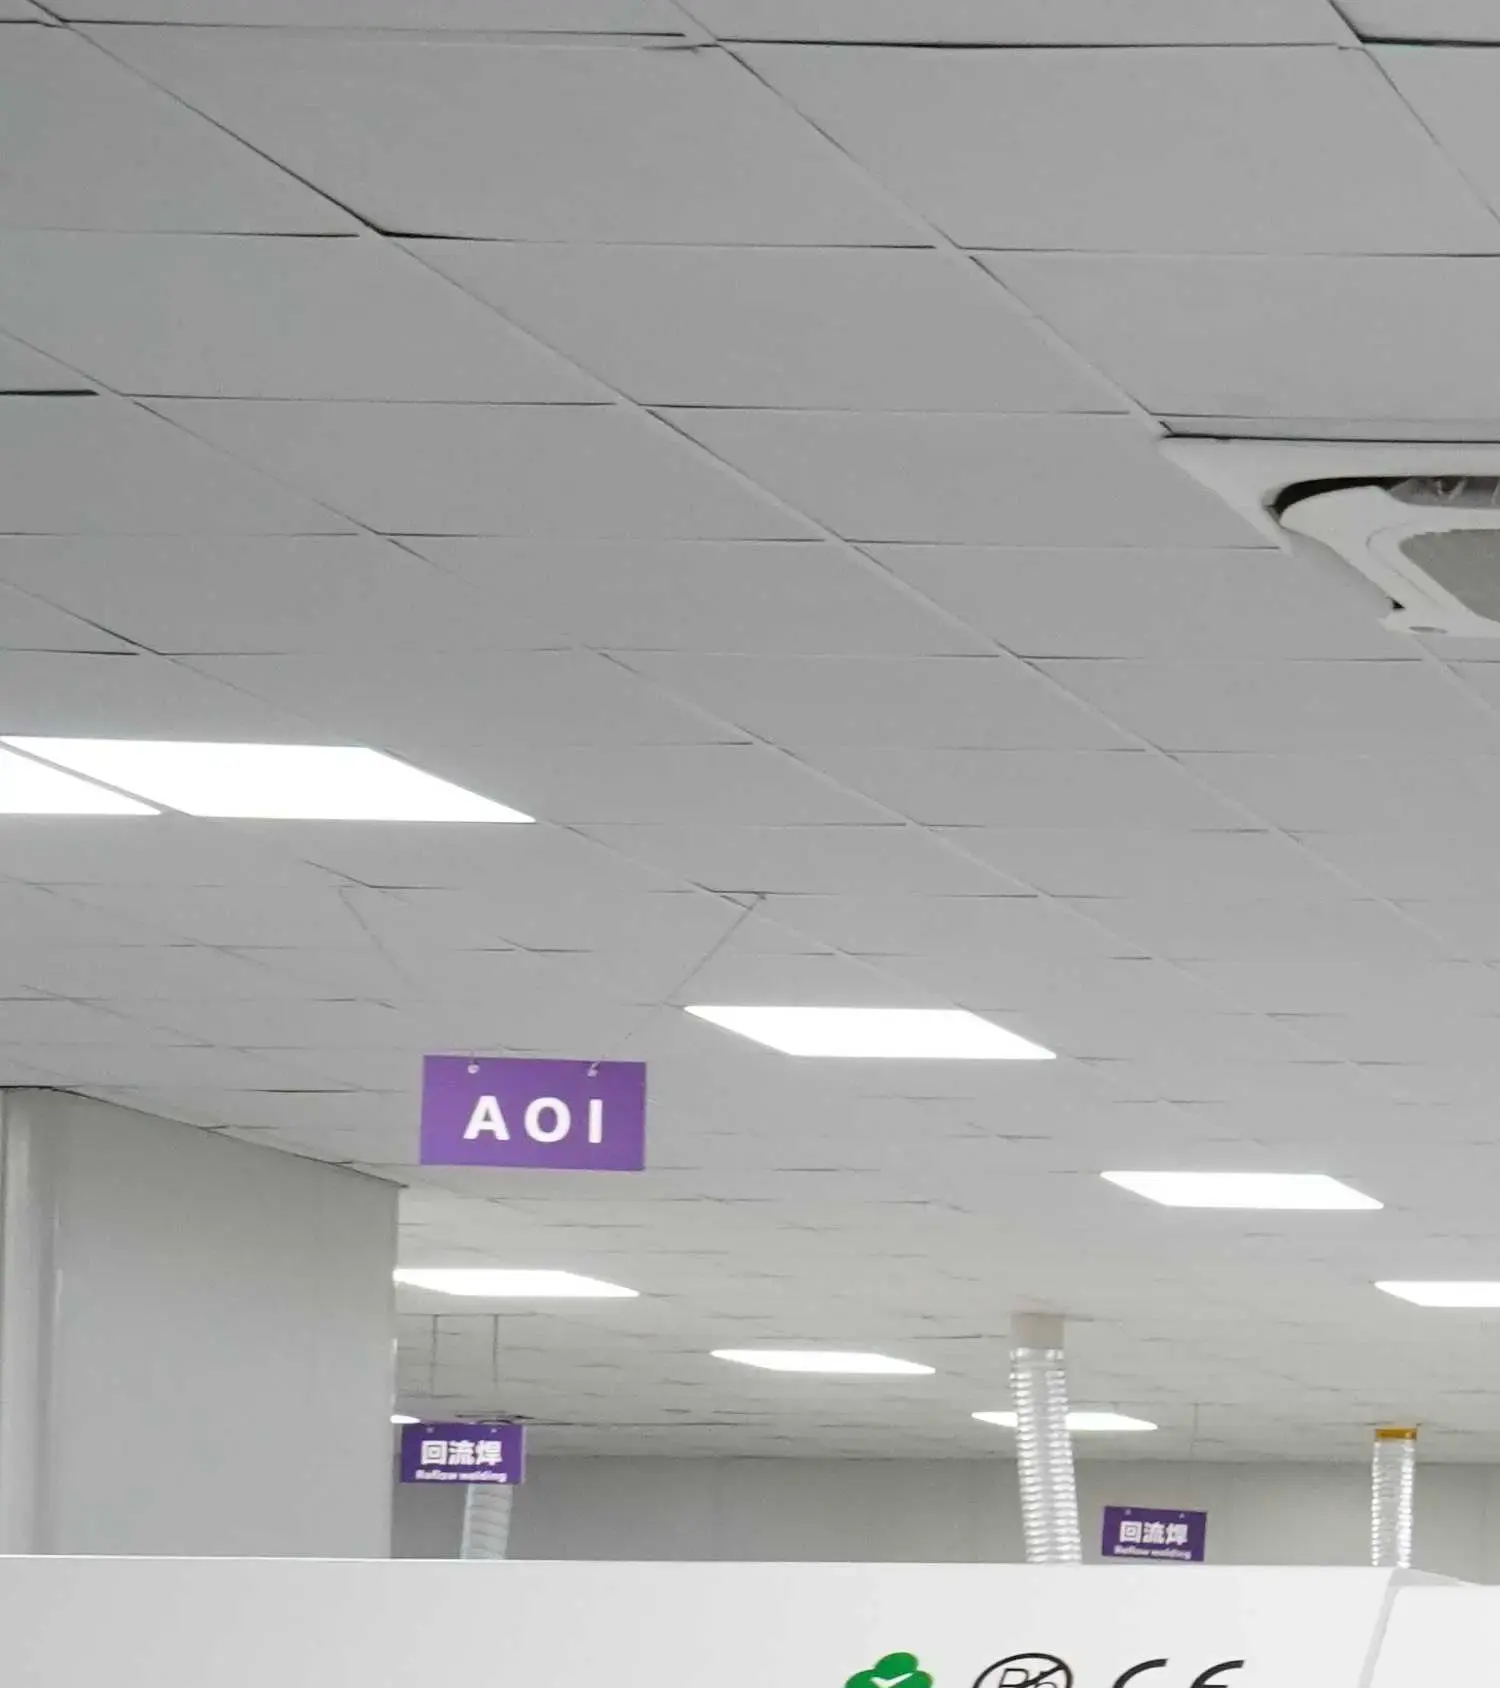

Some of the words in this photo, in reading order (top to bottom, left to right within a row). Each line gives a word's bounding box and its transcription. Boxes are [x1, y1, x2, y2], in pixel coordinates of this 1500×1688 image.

[463, 1095, 604, 1144] AOI
[420, 1439, 504, 1466] 回流焊
[1119, 1520, 1189, 1546] 回流焊
